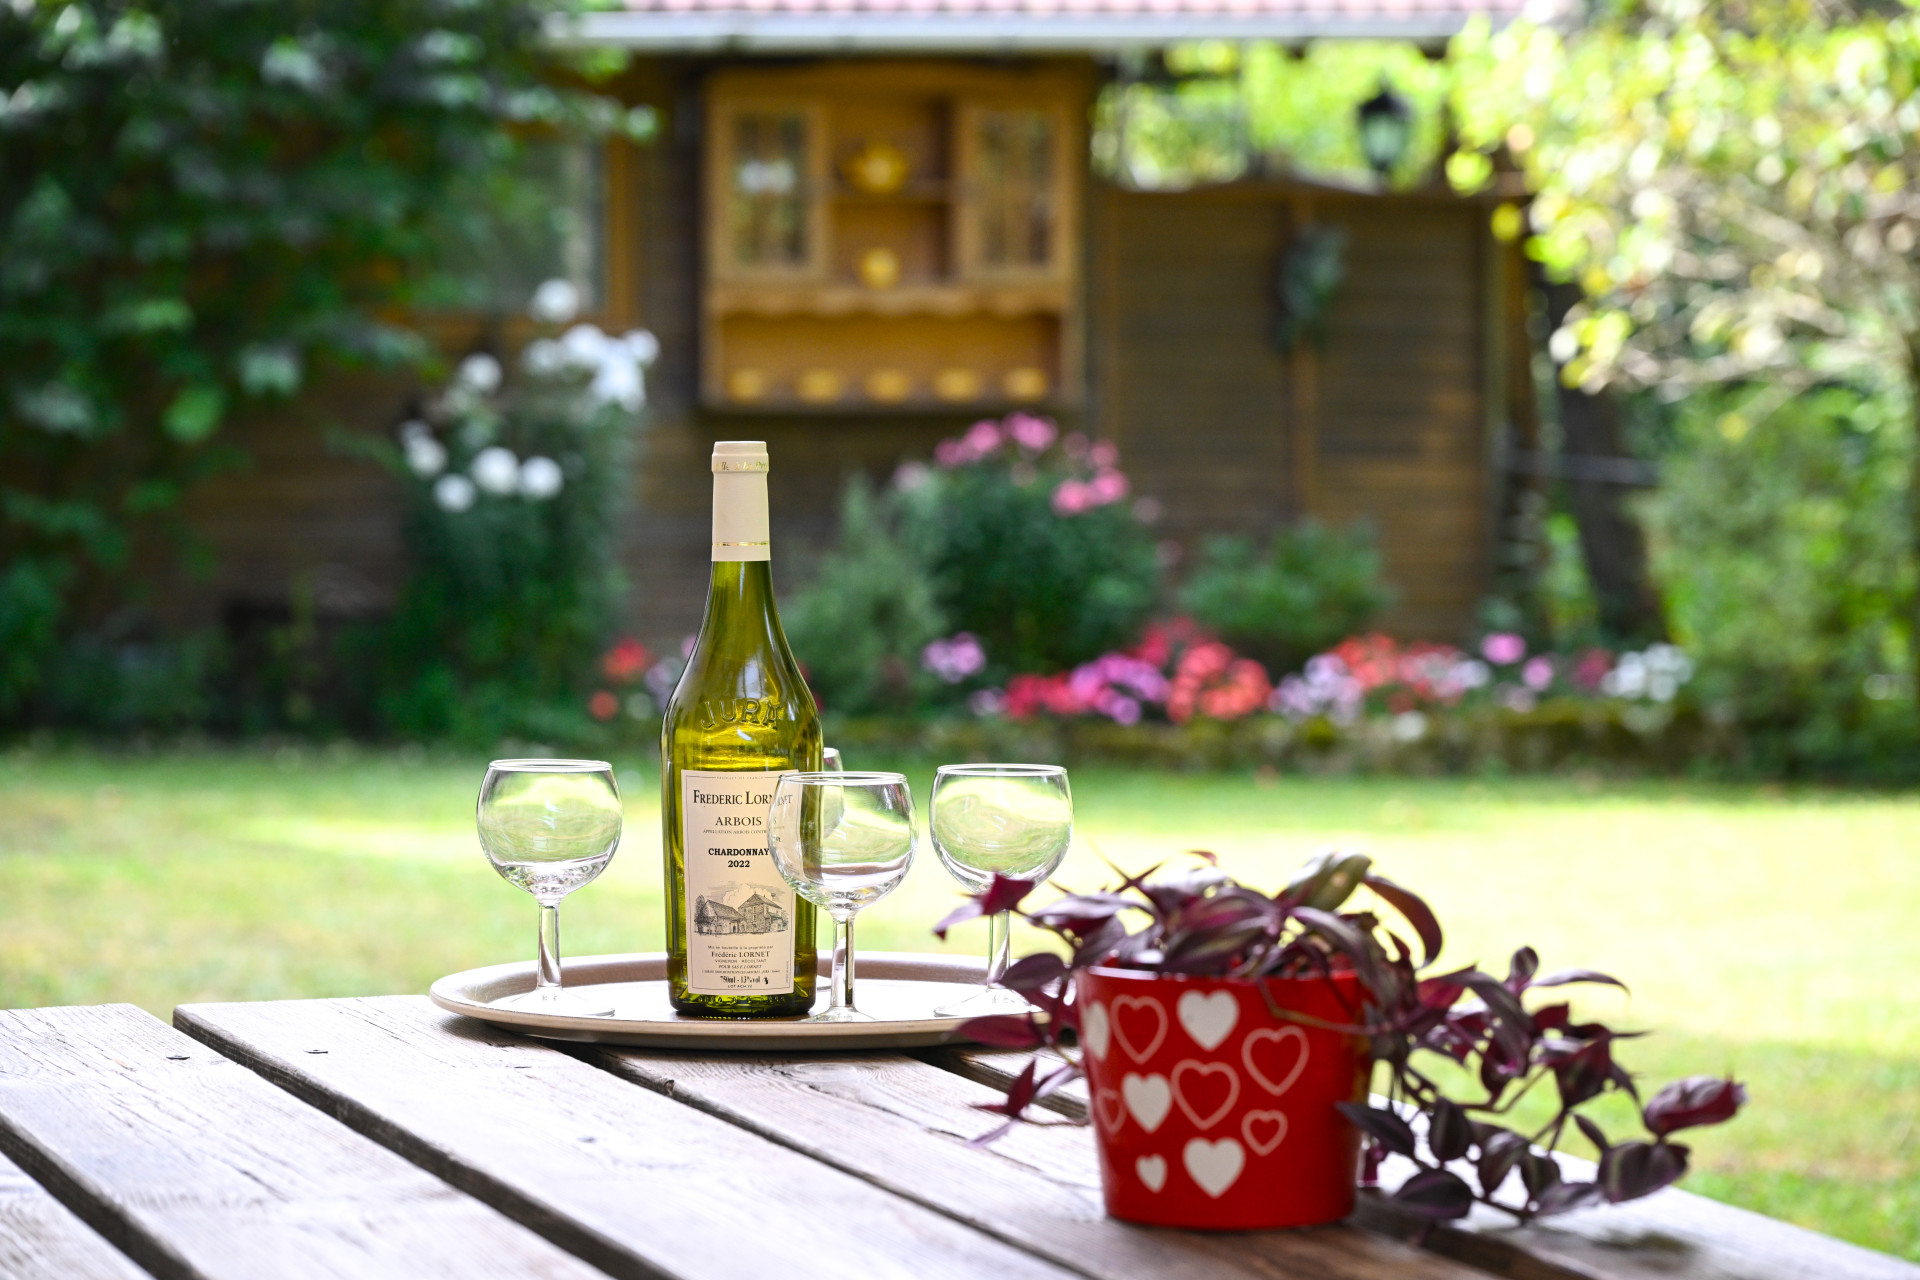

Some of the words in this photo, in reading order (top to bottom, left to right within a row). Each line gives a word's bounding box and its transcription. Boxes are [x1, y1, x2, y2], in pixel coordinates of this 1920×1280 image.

[701, 698, 779, 730] JURA
[715, 816, 762, 827] ARBOIS
[708, 848, 770, 856] CHARDONNAY
[728, 860, 750, 868] 2022
